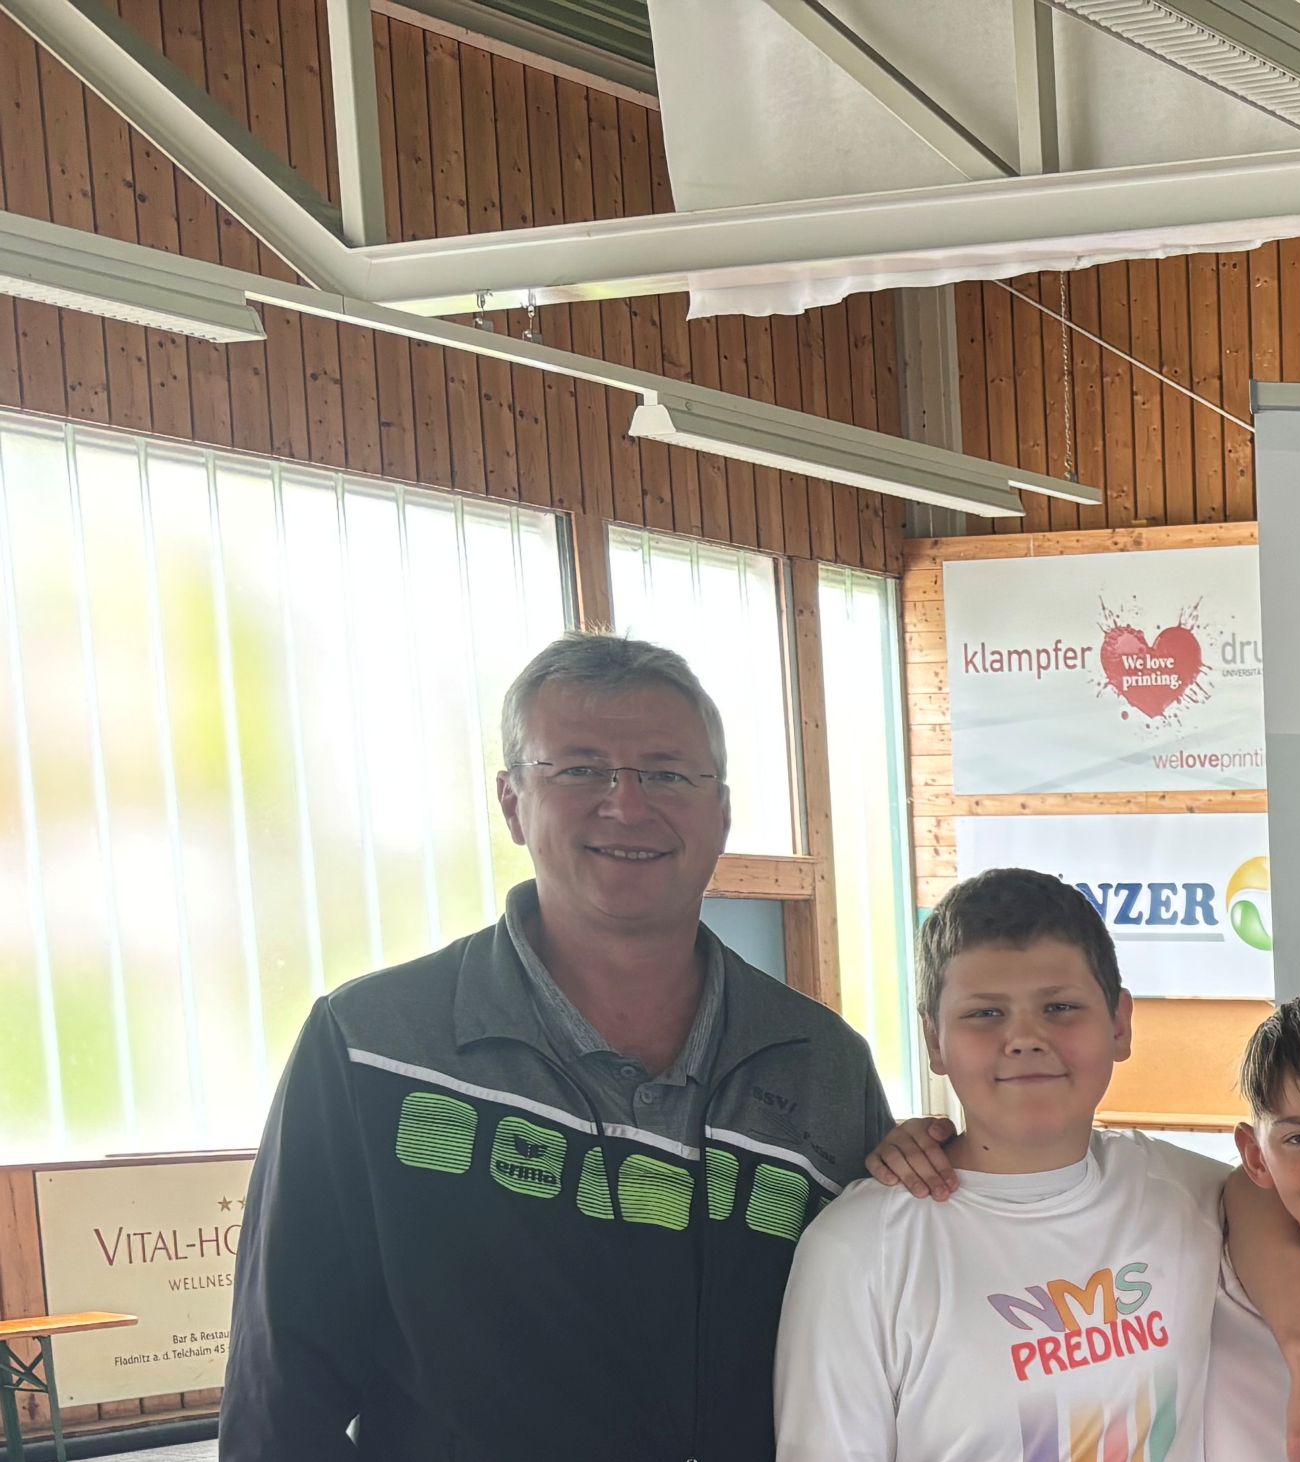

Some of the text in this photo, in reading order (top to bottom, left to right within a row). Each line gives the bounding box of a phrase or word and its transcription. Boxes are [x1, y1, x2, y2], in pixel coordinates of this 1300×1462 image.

[963, 639, 1093, 679] klampfer
[1121, 654, 1175, 671] We love
[1122, 671, 1182, 691] printing.
[1080, 882, 1219, 926] NZER
[496, 1162, 557, 1184] erima
[168, 1274, 233, 1291] WELLNES
[987, 1262, 1152, 1335] NMS
[173, 1334, 187, 1344] Bar
[190, 1333, 198, 1342] &
[1011, 1310, 1169, 1381] PREDING
[114, 1353, 150, 1366] Fladnitz
[214, 1344, 226, 1354] 45
